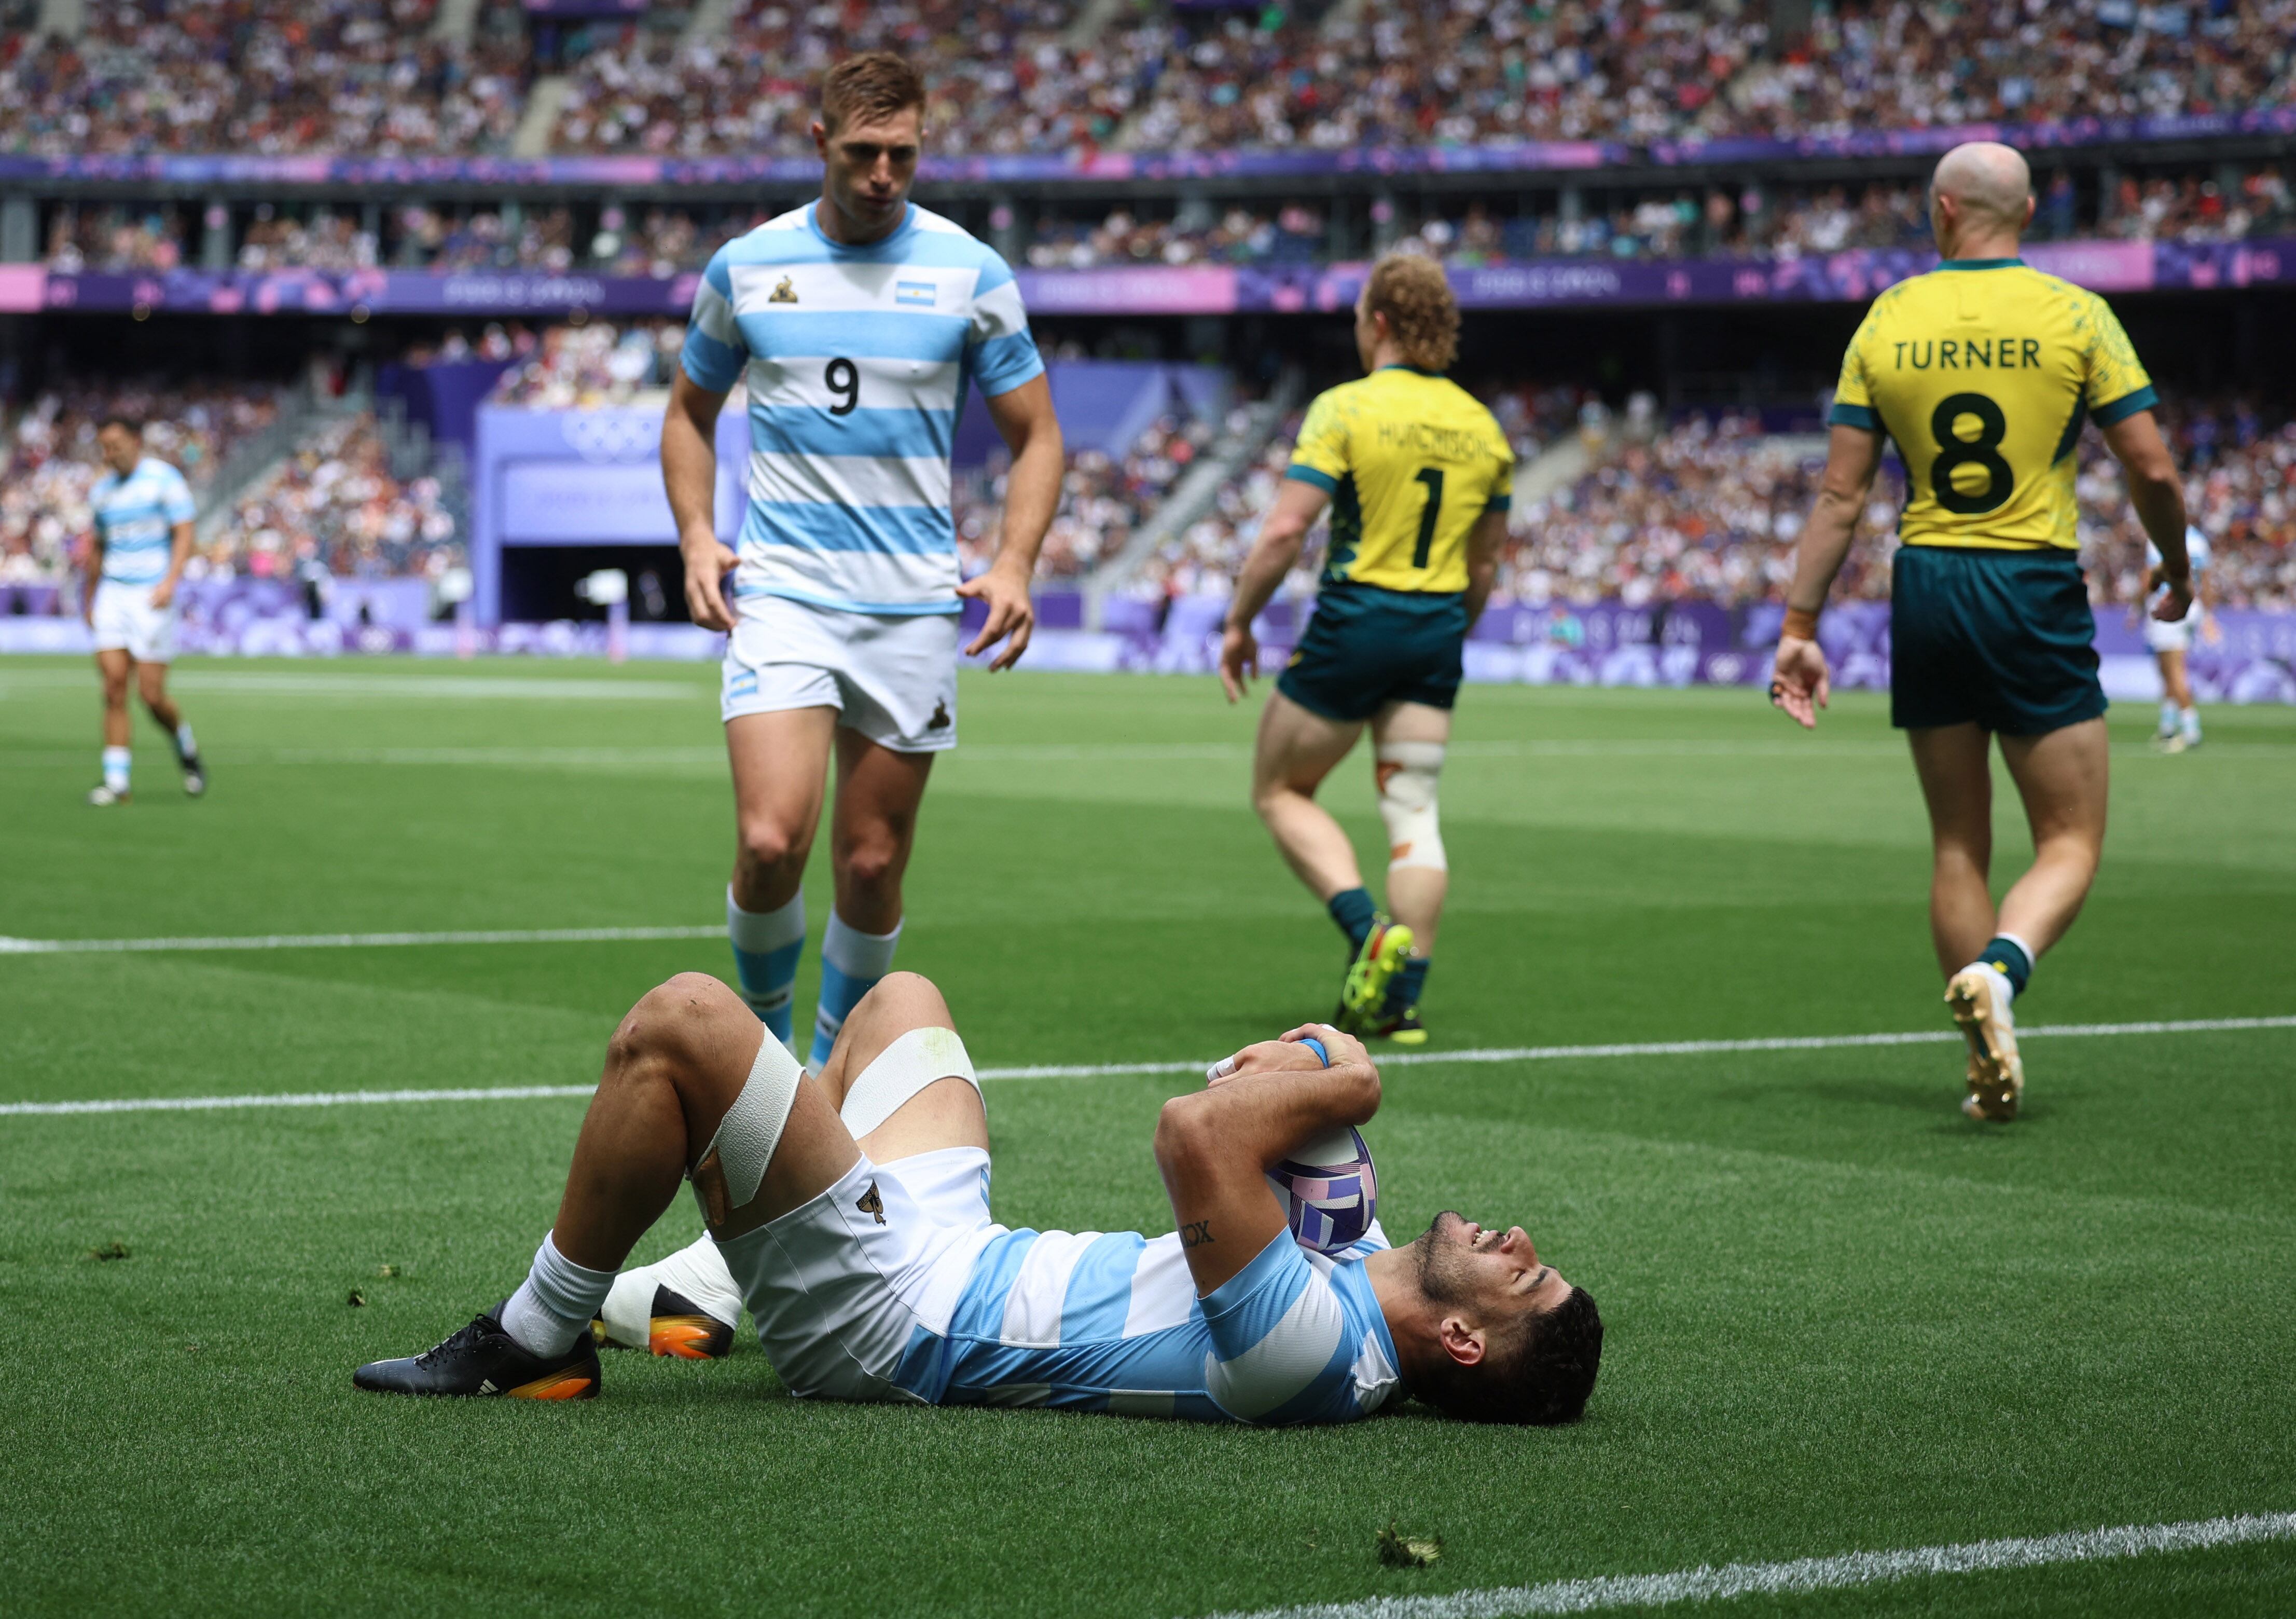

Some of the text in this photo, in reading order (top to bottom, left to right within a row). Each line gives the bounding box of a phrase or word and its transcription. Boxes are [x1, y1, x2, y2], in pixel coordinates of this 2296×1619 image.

[825, 358, 859, 416] 9
[1895, 338, 2041, 370] TURNER
[1931, 392, 2014, 514] 8
[1413, 468, 1444, 568] 1
